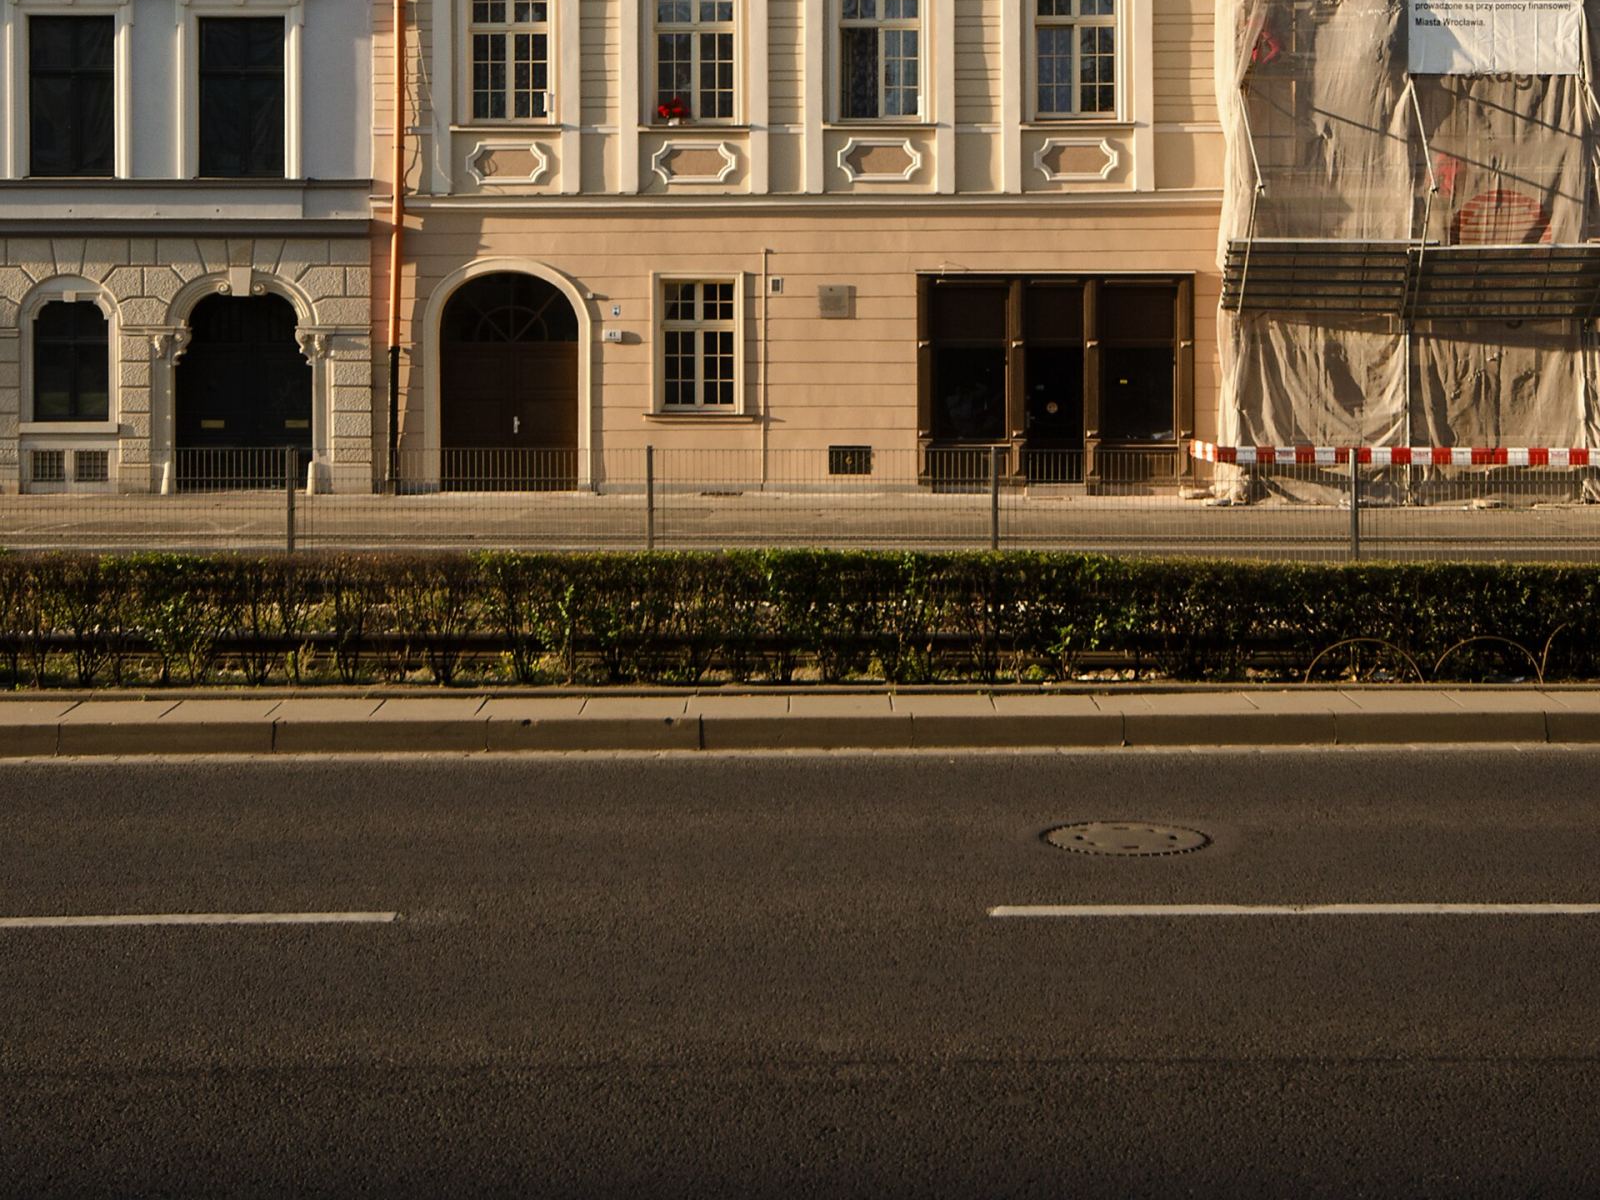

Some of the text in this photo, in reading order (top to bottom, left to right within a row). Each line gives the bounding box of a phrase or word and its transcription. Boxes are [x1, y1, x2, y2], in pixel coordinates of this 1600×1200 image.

[1415, 2, 1571, 12] prowadzone są przy pomocy finansowej
[1415, 18, 1441, 26] Miasta
